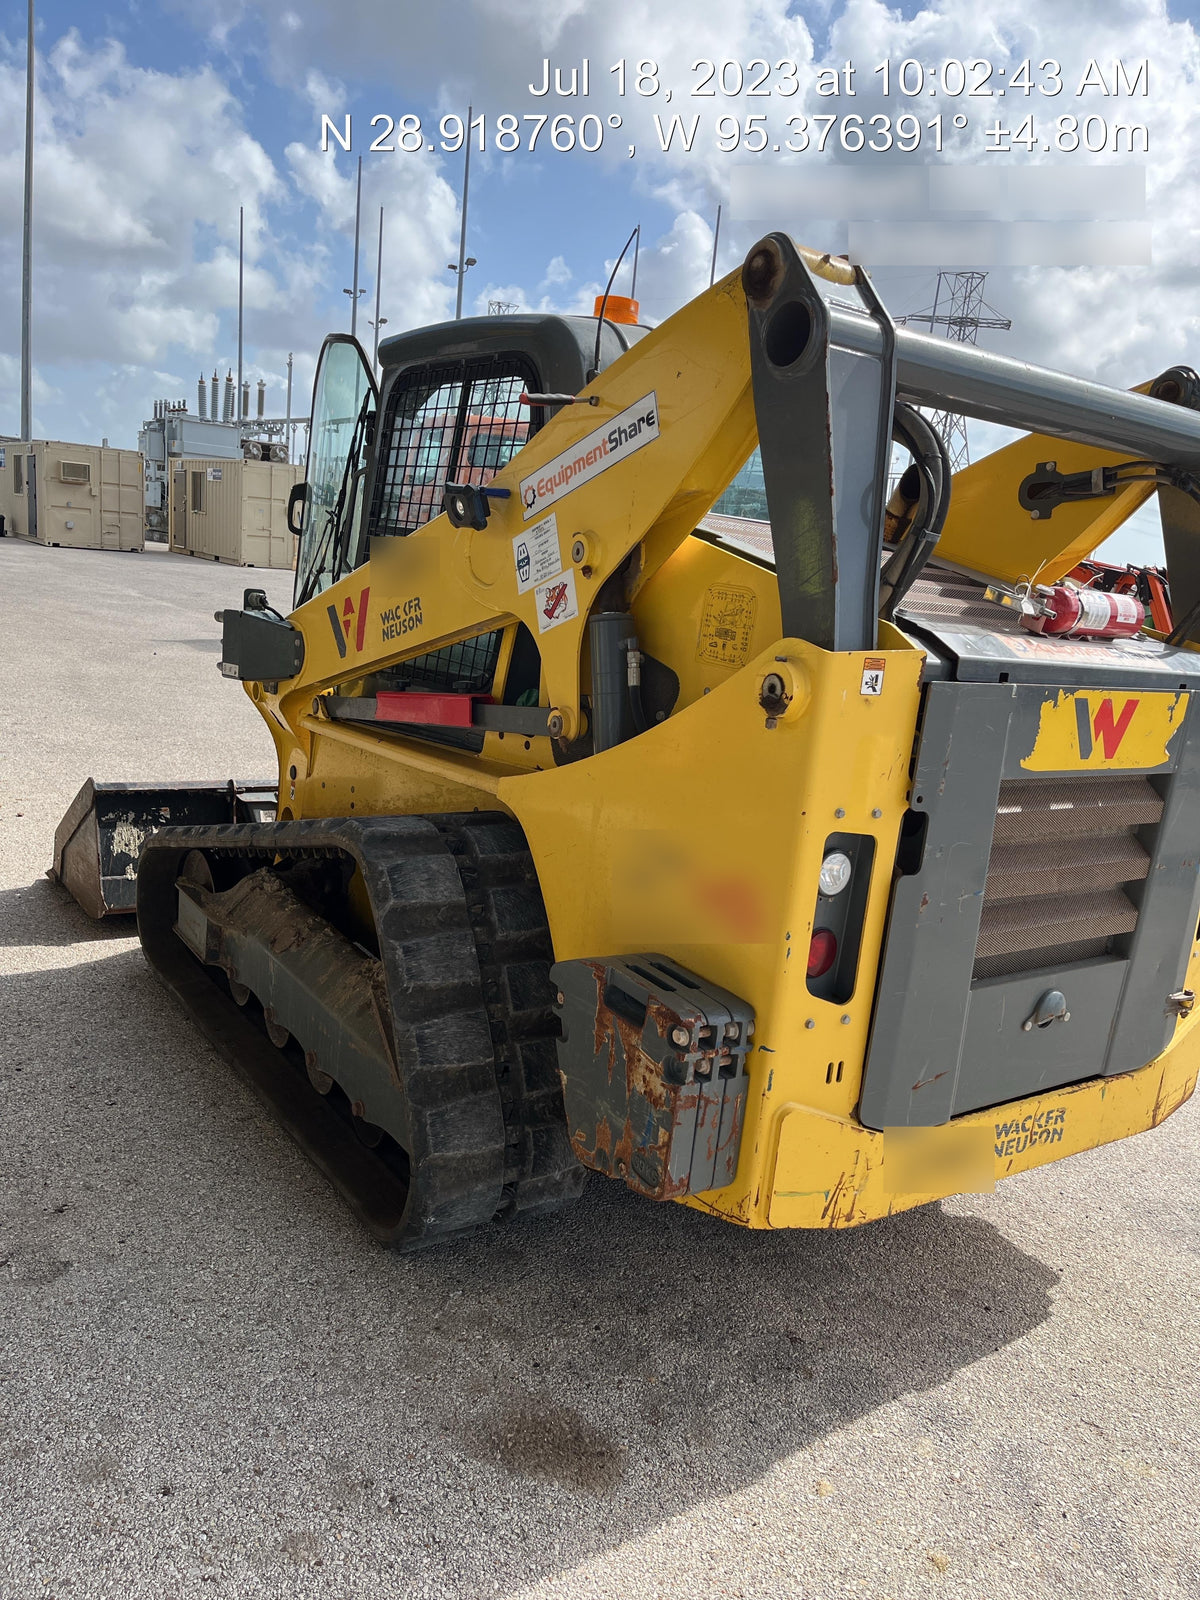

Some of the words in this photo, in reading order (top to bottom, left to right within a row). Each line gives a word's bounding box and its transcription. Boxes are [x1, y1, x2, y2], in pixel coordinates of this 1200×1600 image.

[536, 409, 656, 498] EquipmentShare
[381, 611, 424, 643] NEUSON
[994, 1106, 1067, 1140] WACKER
[994, 1127, 1065, 1158] NEUSON
